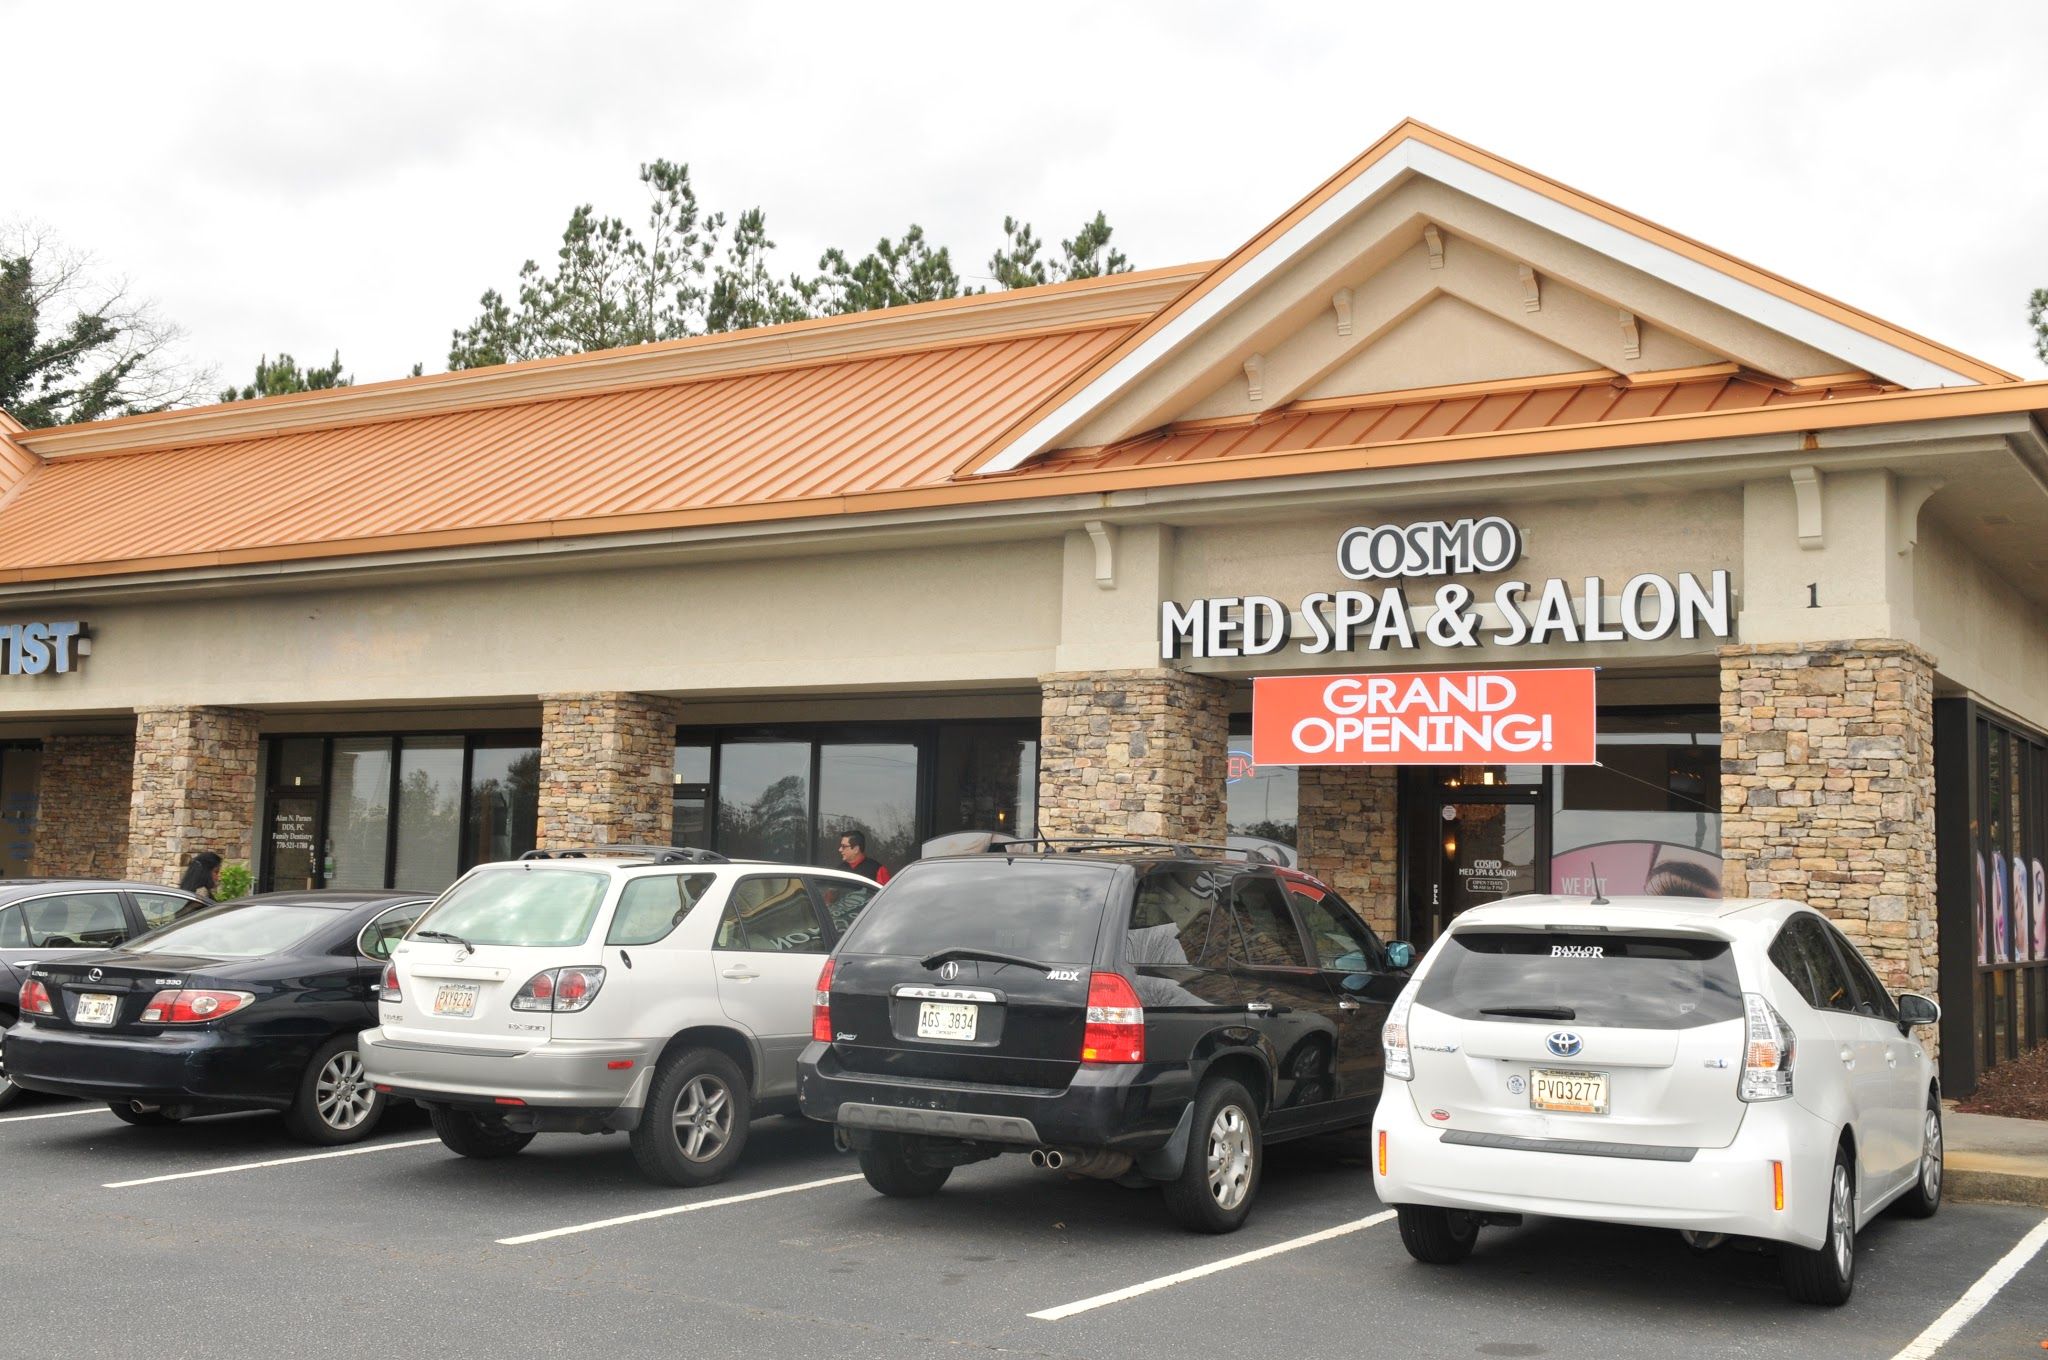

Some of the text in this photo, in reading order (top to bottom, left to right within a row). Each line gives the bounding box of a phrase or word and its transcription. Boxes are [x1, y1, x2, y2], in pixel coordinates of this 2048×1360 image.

[1337, 516, 1518, 580] COSMO
[1806, 582, 1822, 609] 1
[1161, 569, 1730, 659] MED SPA & SALON
[1322, 675, 1517, 715] GRAND
[1291, 713, 1553, 754] OPENING!
[1225, 756, 1255, 778] EN
[296, 823, 305, 831] PC
[272, 832, 313, 842] Family Dentistry
[1458, 868, 1517, 877] MED SPA & SALON
[1473, 859, 1502, 869] COSMO
[1561, 877, 1608, 895] WE PUT
[1550, 945, 1604, 959] BAYLOR
[1046, 970, 1080, 982] MDX
[914, 989, 977, 1000] ACURA
[921, 1011, 974, 1031] AGS 3834
[1538, 1079, 1600, 1102] PVQ3277
